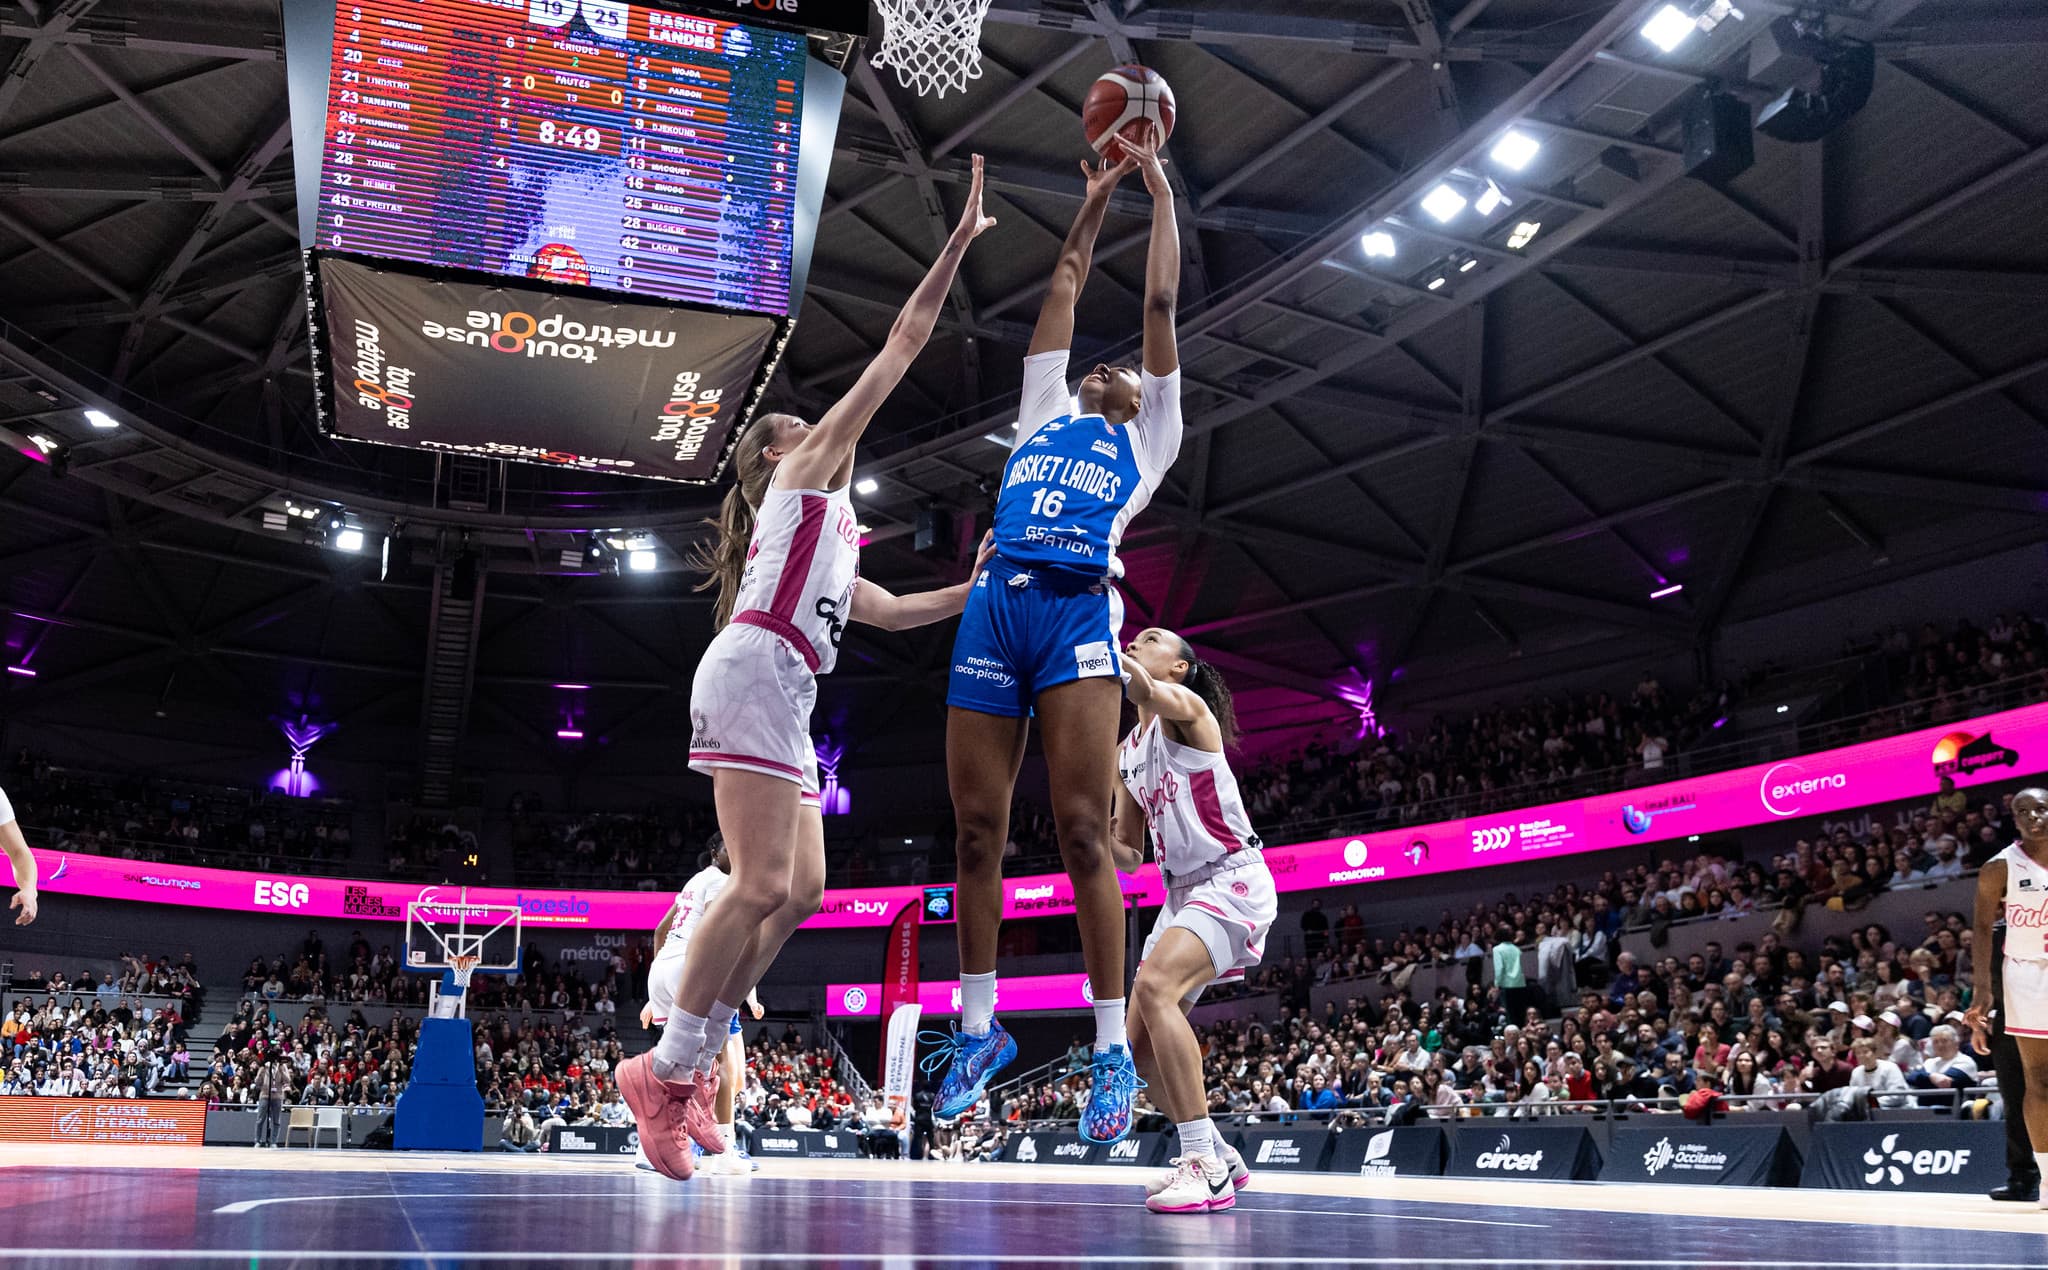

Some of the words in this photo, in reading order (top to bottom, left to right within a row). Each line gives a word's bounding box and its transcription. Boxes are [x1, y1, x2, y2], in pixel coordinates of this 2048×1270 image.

[351, 7, 362, 21] 3
[543, 0, 563, 16] 19
[594, 9, 619, 26] 25
[648, 12, 718, 34] BASKET
[349, 29, 360, 42] 4
[505, 37, 515, 48] 6
[648, 27, 716, 49] LANDES
[343, 49, 363, 63] 20
[570, 56, 579, 67] 2
[639, 57, 649, 71] 2
[341, 69, 360, 83] 21
[502, 77, 512, 88] 2
[524, 76, 536, 90] 0
[555, 75, 591, 89] FAUTES
[637, 78, 648, 91] 5
[340, 90, 359, 104] 23
[500, 97, 510, 109] 2
[610, 90, 623, 105] 0
[636, 98, 647, 110] 7
[338, 111, 358, 125] 25
[499, 118, 509, 129] 5
[634, 119, 645, 131] 9
[778, 122, 787, 134] 2
[336, 130, 357, 145] 27
[540, 120, 601, 151] 8:49
[629, 137, 646, 151] 11
[777, 142, 786, 153] 4
[334, 151, 354, 166] 28
[495, 157, 505, 169] 4
[628, 157, 646, 170] 13
[776, 162, 785, 173] 6
[333, 172, 353, 186] 32
[626, 176, 644, 190] 16
[774, 180, 784, 193] 3
[331, 193, 351, 207] 45
[352, 198, 365, 207] DE
[366, 200, 403, 212] FREITAS
[625, 195, 643, 209] 25
[334, 214, 344, 227] 0
[623, 215, 641, 230] 28
[771, 219, 781, 231] 7
[332, 234, 343, 247] 0
[621, 236, 640, 250] 42
[570, 261, 611, 275] TOULOUSE
[624, 256, 634, 269] 0
[769, 259, 778, 271] 3
[466, 310, 677, 349] métropole
[422, 320, 598, 364] toulouse
[351, 318, 386, 410] métropole
[381, 365, 416, 430] toulouse
[650, 371, 701, 442] toulouse
[674, 388, 723, 462] métropole
[1093, 439, 1118, 453] AVIA
[1005, 454, 1065, 490] BASKET
[1059, 457, 1122, 503] LANDES
[1030, 487, 1067, 518] 16
[966, 656, 1004, 672] maison
[954, 664, 1011, 685] coco-picoty
[1772, 774, 1847, 799] externa
[1328, 866, 1385, 882] PROMOTION
[253, 880, 309, 908] ESG
[346, 887, 366, 896] LES
[1014, 885, 1055, 900] Rapid
[344, 905, 399, 916] MUSIQUES
[517, 894, 590, 914] koesio
[95, 1104, 149, 1117] CAISSE
[94, 1117, 178, 1130] D'EPARGNE
[1475, 1147, 1544, 1172] circet
[1674, 1151, 1728, 1165] Occitanie
